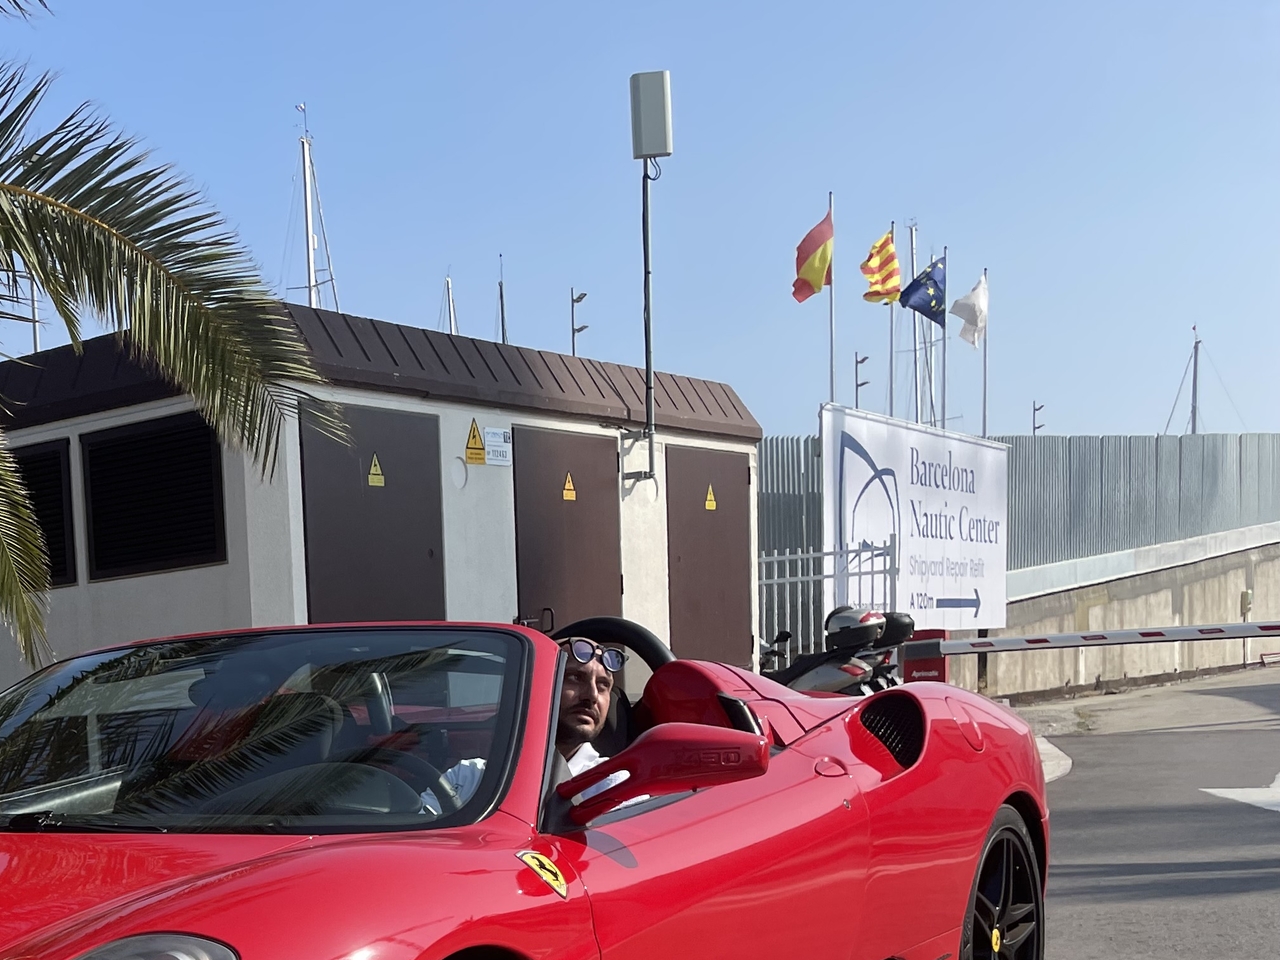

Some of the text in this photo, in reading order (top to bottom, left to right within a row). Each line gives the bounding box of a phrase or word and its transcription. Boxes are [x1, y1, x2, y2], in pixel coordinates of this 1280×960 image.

[910, 447, 975, 494] Barcelona
[910, 500, 1000, 544] Nautic Center
[910, 554, 985, 583] Shipyard Repair Refit
[910, 592, 934, 609] A 120m
